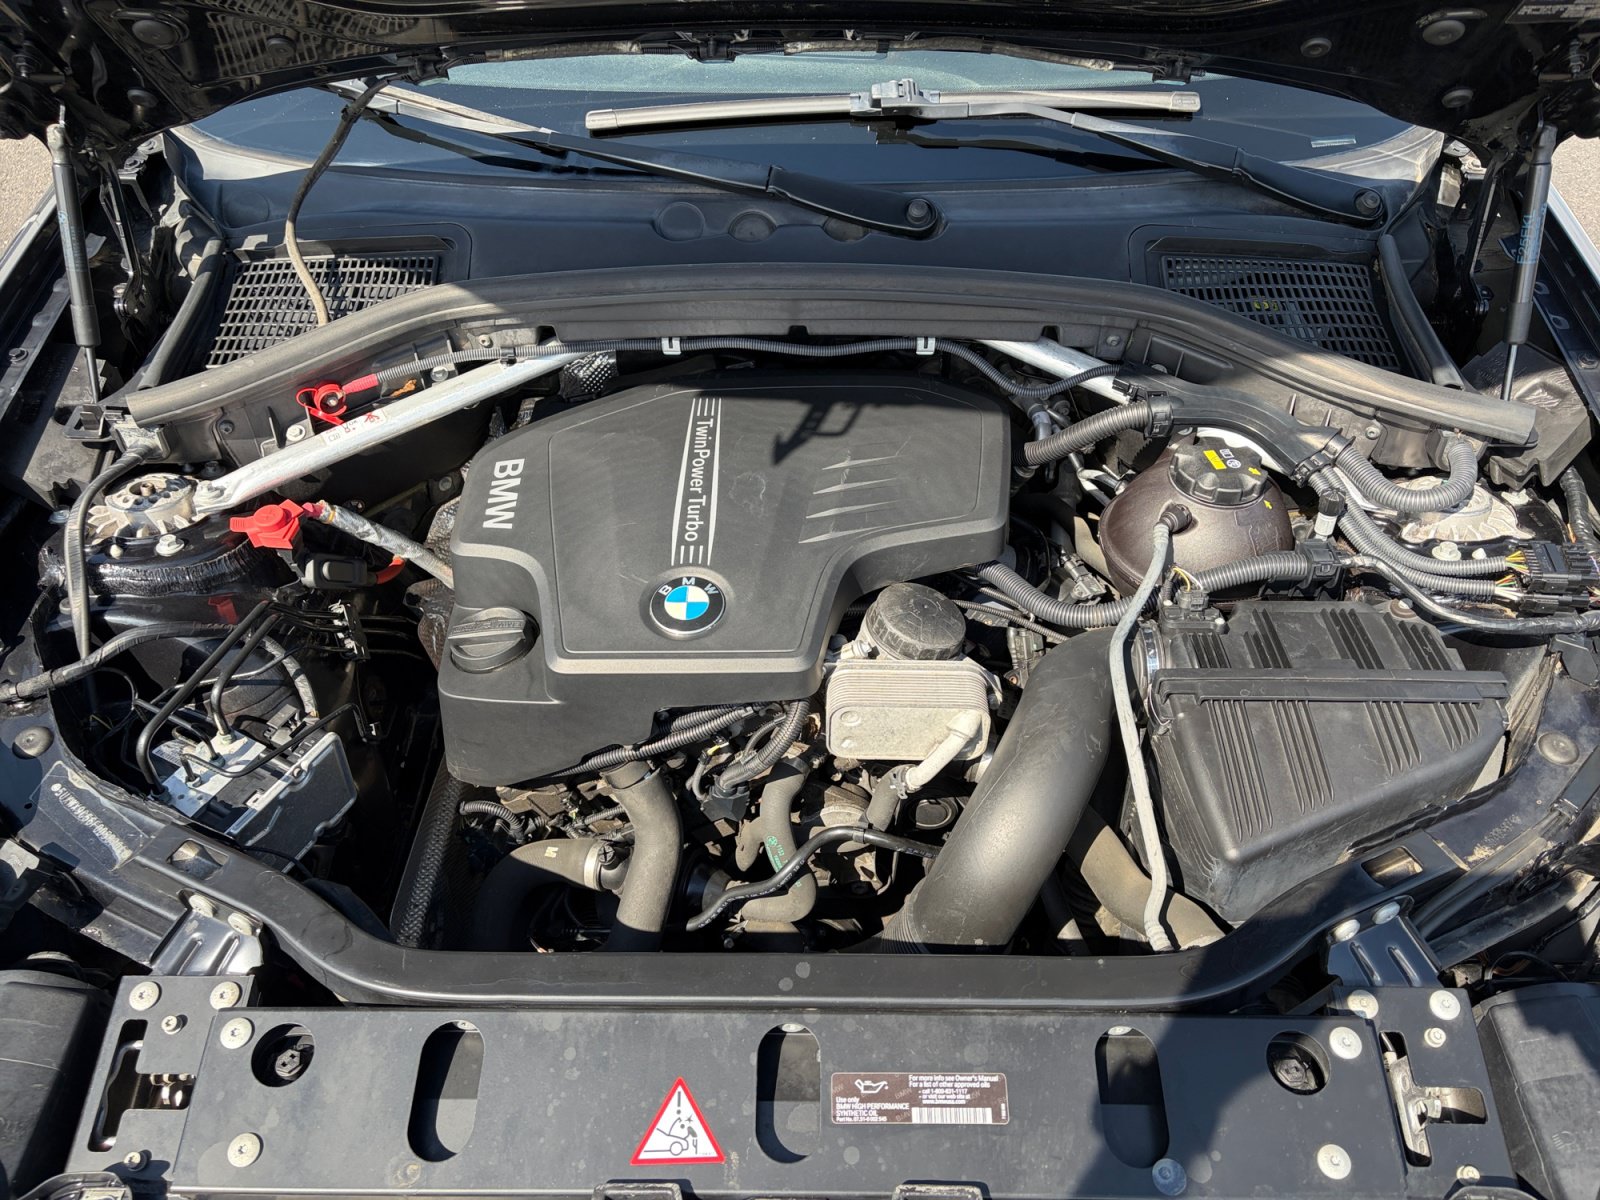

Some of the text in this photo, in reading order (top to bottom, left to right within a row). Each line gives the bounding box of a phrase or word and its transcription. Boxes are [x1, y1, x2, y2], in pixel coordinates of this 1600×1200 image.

[482, 458, 525, 529] BMW
[684, 418, 714, 542] TwinPower Turbo
[658, 577, 719, 595] BMW
[847, 1096, 860, 1104] only
